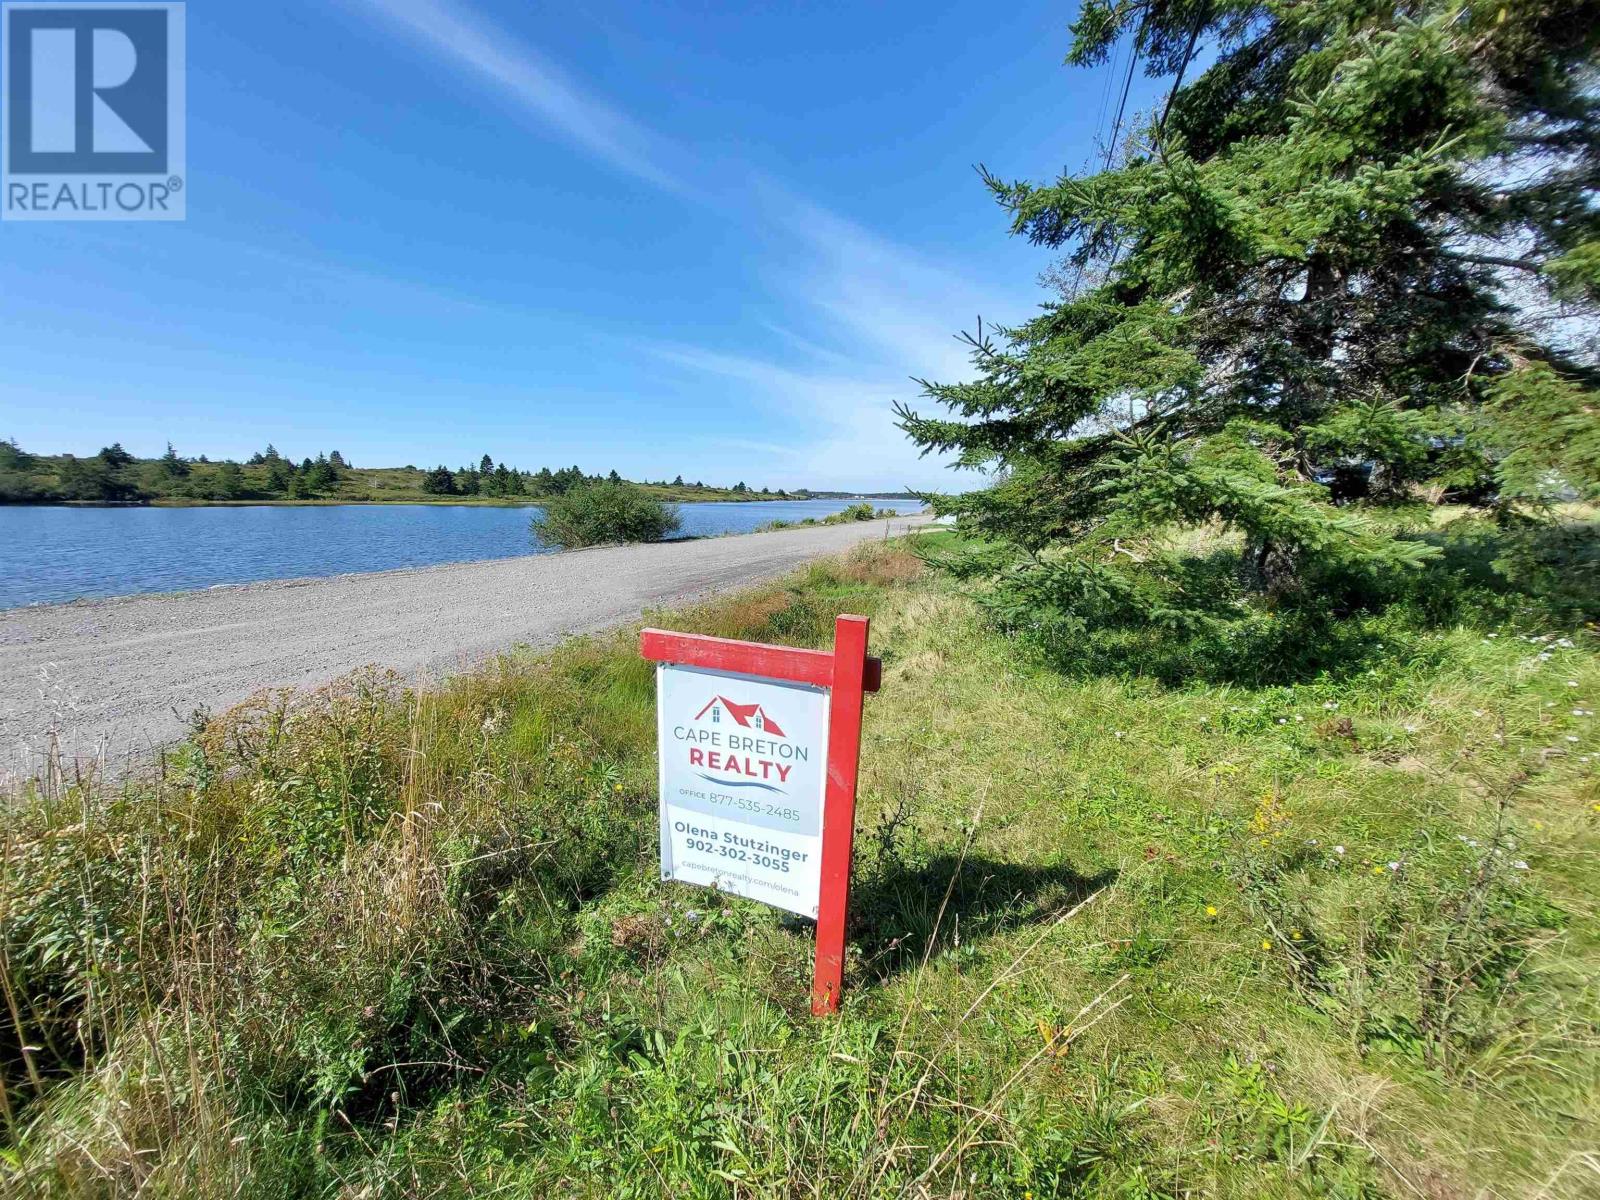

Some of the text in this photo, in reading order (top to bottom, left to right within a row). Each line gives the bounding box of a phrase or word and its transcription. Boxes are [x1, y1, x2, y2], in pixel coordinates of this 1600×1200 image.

[673, 725, 808, 762] CAPE BRETON
[689, 747, 792, 783] REALTY
[679, 788, 800, 822] OFFICE 877-535-2485
[674, 821, 809, 864] Olena Stutzinger
[686, 838, 790, 874] 902-302-3055
[681, 859, 800, 897] capebretonrealty.com/olena
